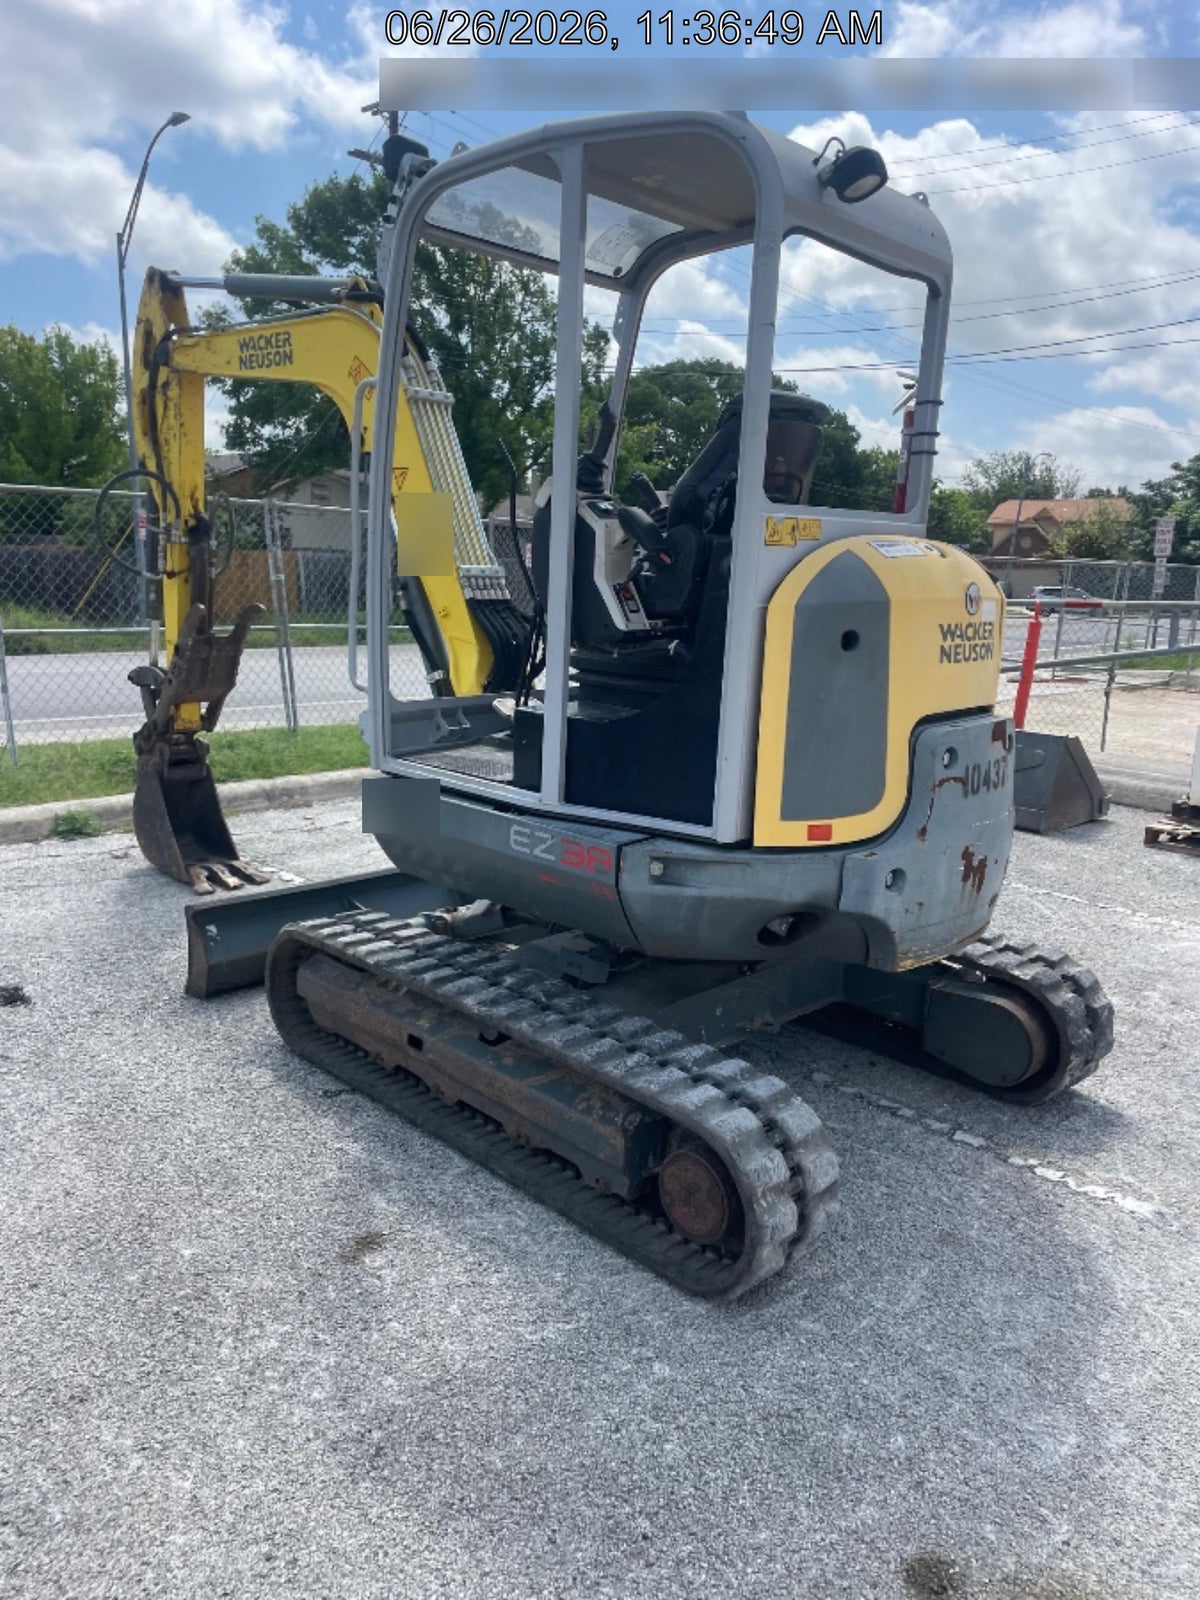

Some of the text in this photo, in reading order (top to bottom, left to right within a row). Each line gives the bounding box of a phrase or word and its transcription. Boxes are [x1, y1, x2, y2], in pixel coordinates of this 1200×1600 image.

[238, 331, 292, 354] WACKER
[239, 348, 293, 370] NEUSON
[938, 621, 994, 642] WACKER
[939, 642, 994, 664] NEUSON
